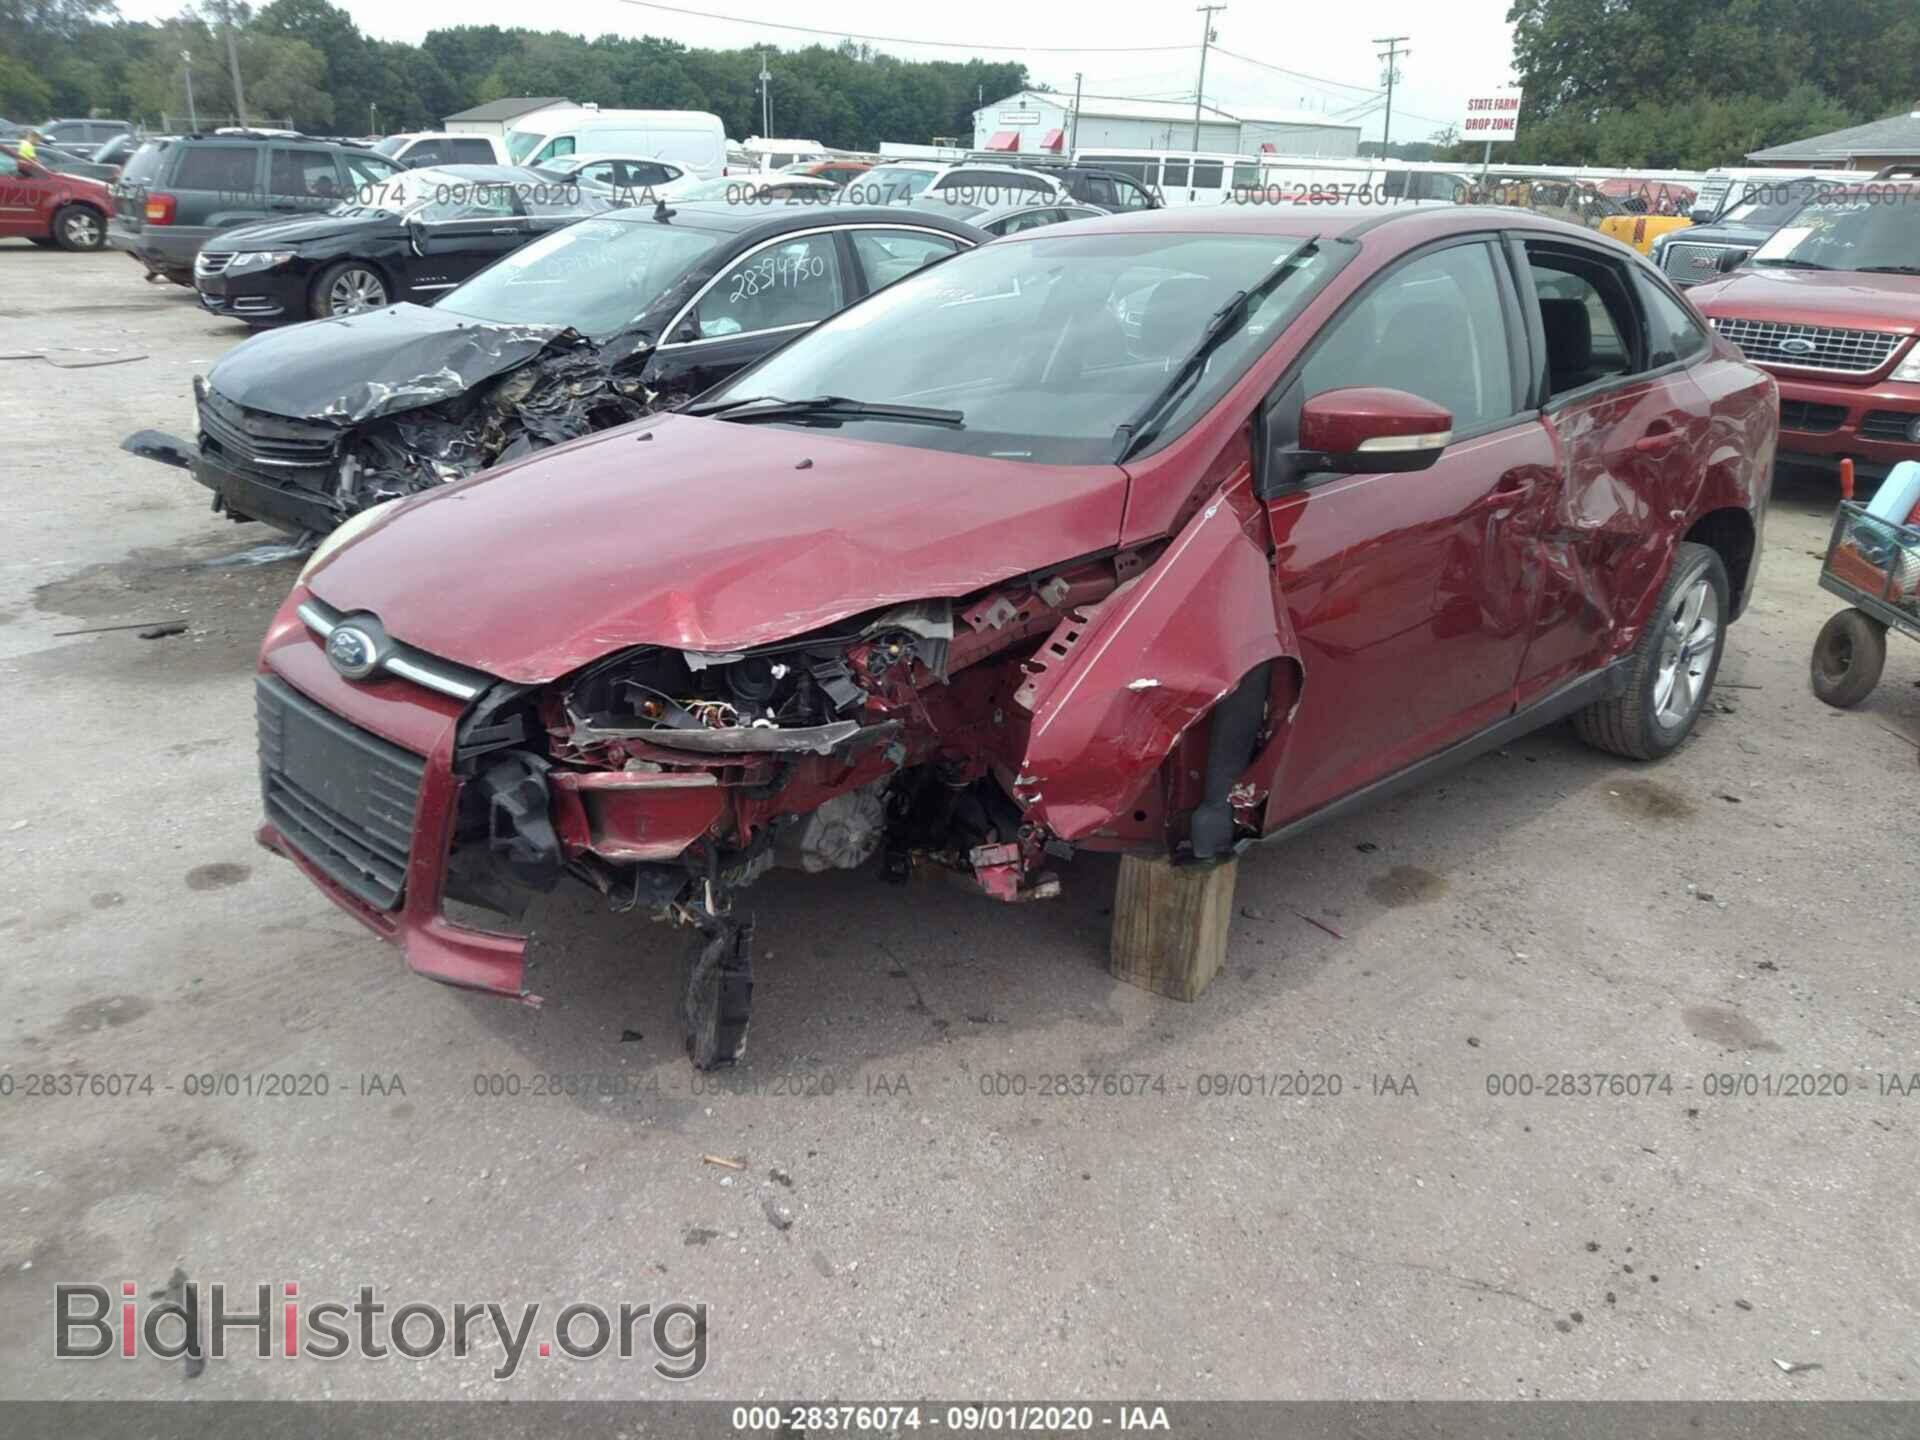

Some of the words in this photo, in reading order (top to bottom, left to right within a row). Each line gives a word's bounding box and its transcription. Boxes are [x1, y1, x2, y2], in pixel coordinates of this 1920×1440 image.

[1468, 98, 1493, 110] STATE
[1495, 98, 1518, 110] FARM
[1465, 118, 1490, 130] DROP
[1492, 118, 1515, 130] ZONE
